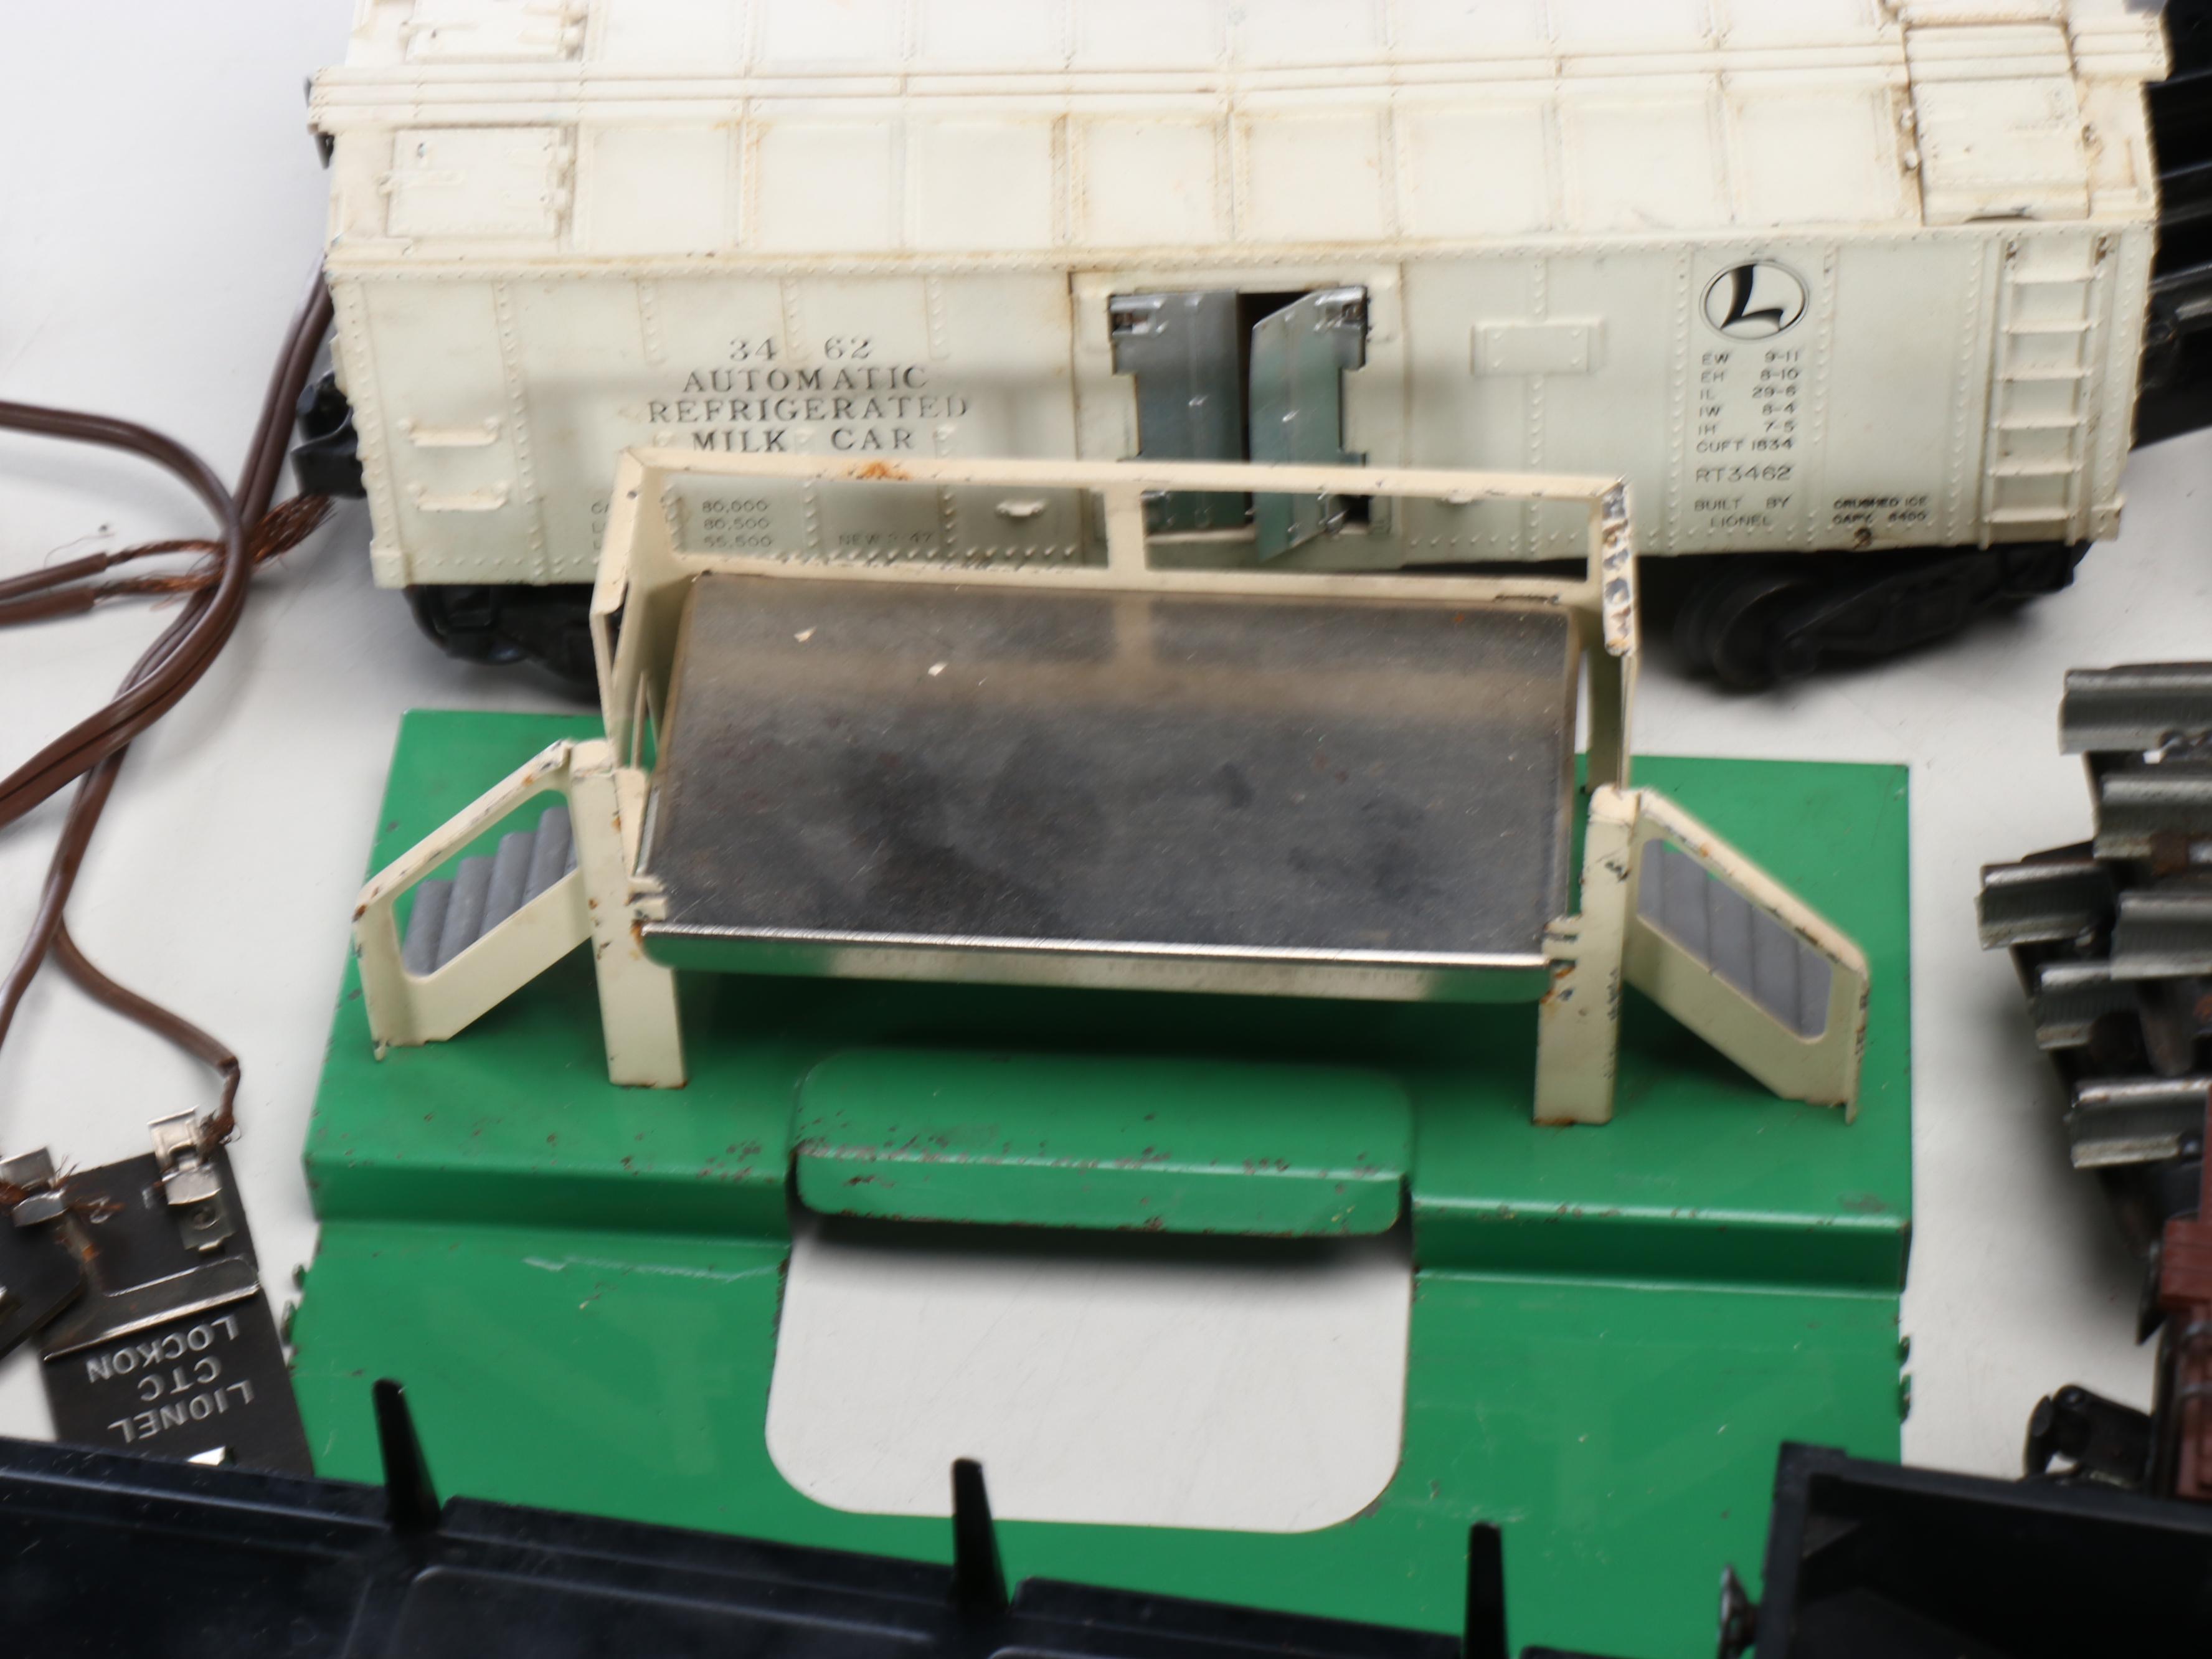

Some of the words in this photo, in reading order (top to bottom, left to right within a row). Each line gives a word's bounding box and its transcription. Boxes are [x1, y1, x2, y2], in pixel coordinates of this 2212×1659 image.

[729, 337, 777, 361] 34
[824, 336, 872, 361] 62
[1702, 352, 1729, 366] EW
[683, 366, 928, 394] AUTOMATIC
[1701, 371, 1724, 383] EH
[1760, 367, 1800, 381] 8-10
[647, 394, 968, 424] REFRIGERATED
[692, 429, 788, 453] MILK
[830, 427, 915, 451] CAR
[1695, 465, 1794, 483] RT3462
[1694, 498, 1743, 512] BUILT
[1766, 495, 1794, 509] BY
[1711, 514, 1773, 527] LIONEL
[86, 1315, 239, 1383] LOCKON
[137, 1355, 221, 1402] CTC
[107, 1379, 254, 1444] LIONEL
